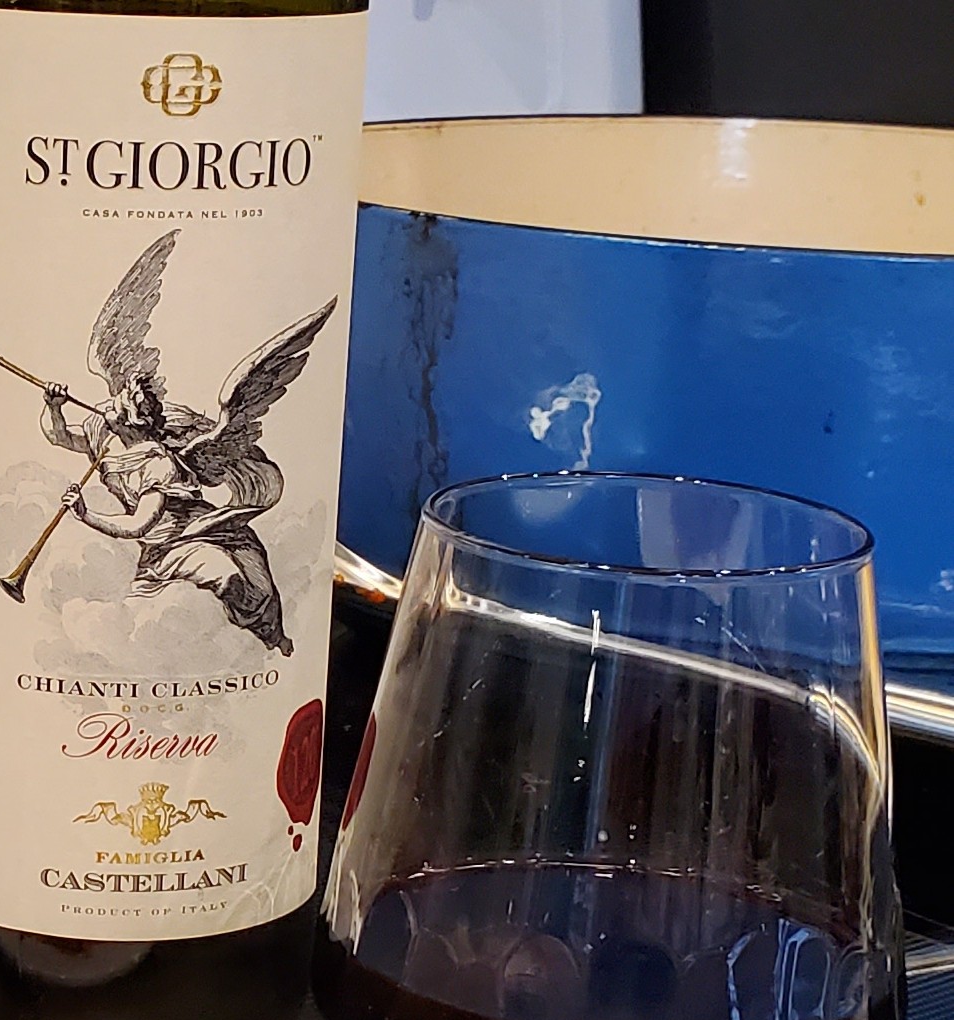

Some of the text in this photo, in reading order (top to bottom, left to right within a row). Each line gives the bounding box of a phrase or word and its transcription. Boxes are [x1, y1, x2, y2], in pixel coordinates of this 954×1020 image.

[86, 138, 311, 191] GIORGIO
[82, 208, 264, 219] CASA FONDATA NEL 1903
[17, 669, 279, 699] CHIANTI CLASSICO
[61, 712, 219, 760] Riserva
[96, 849, 205, 865] FAMIGLIA
[40, 862, 249, 893] CASTELLANI
[61, 901, 228, 917] PRODUCT OF ITALY
